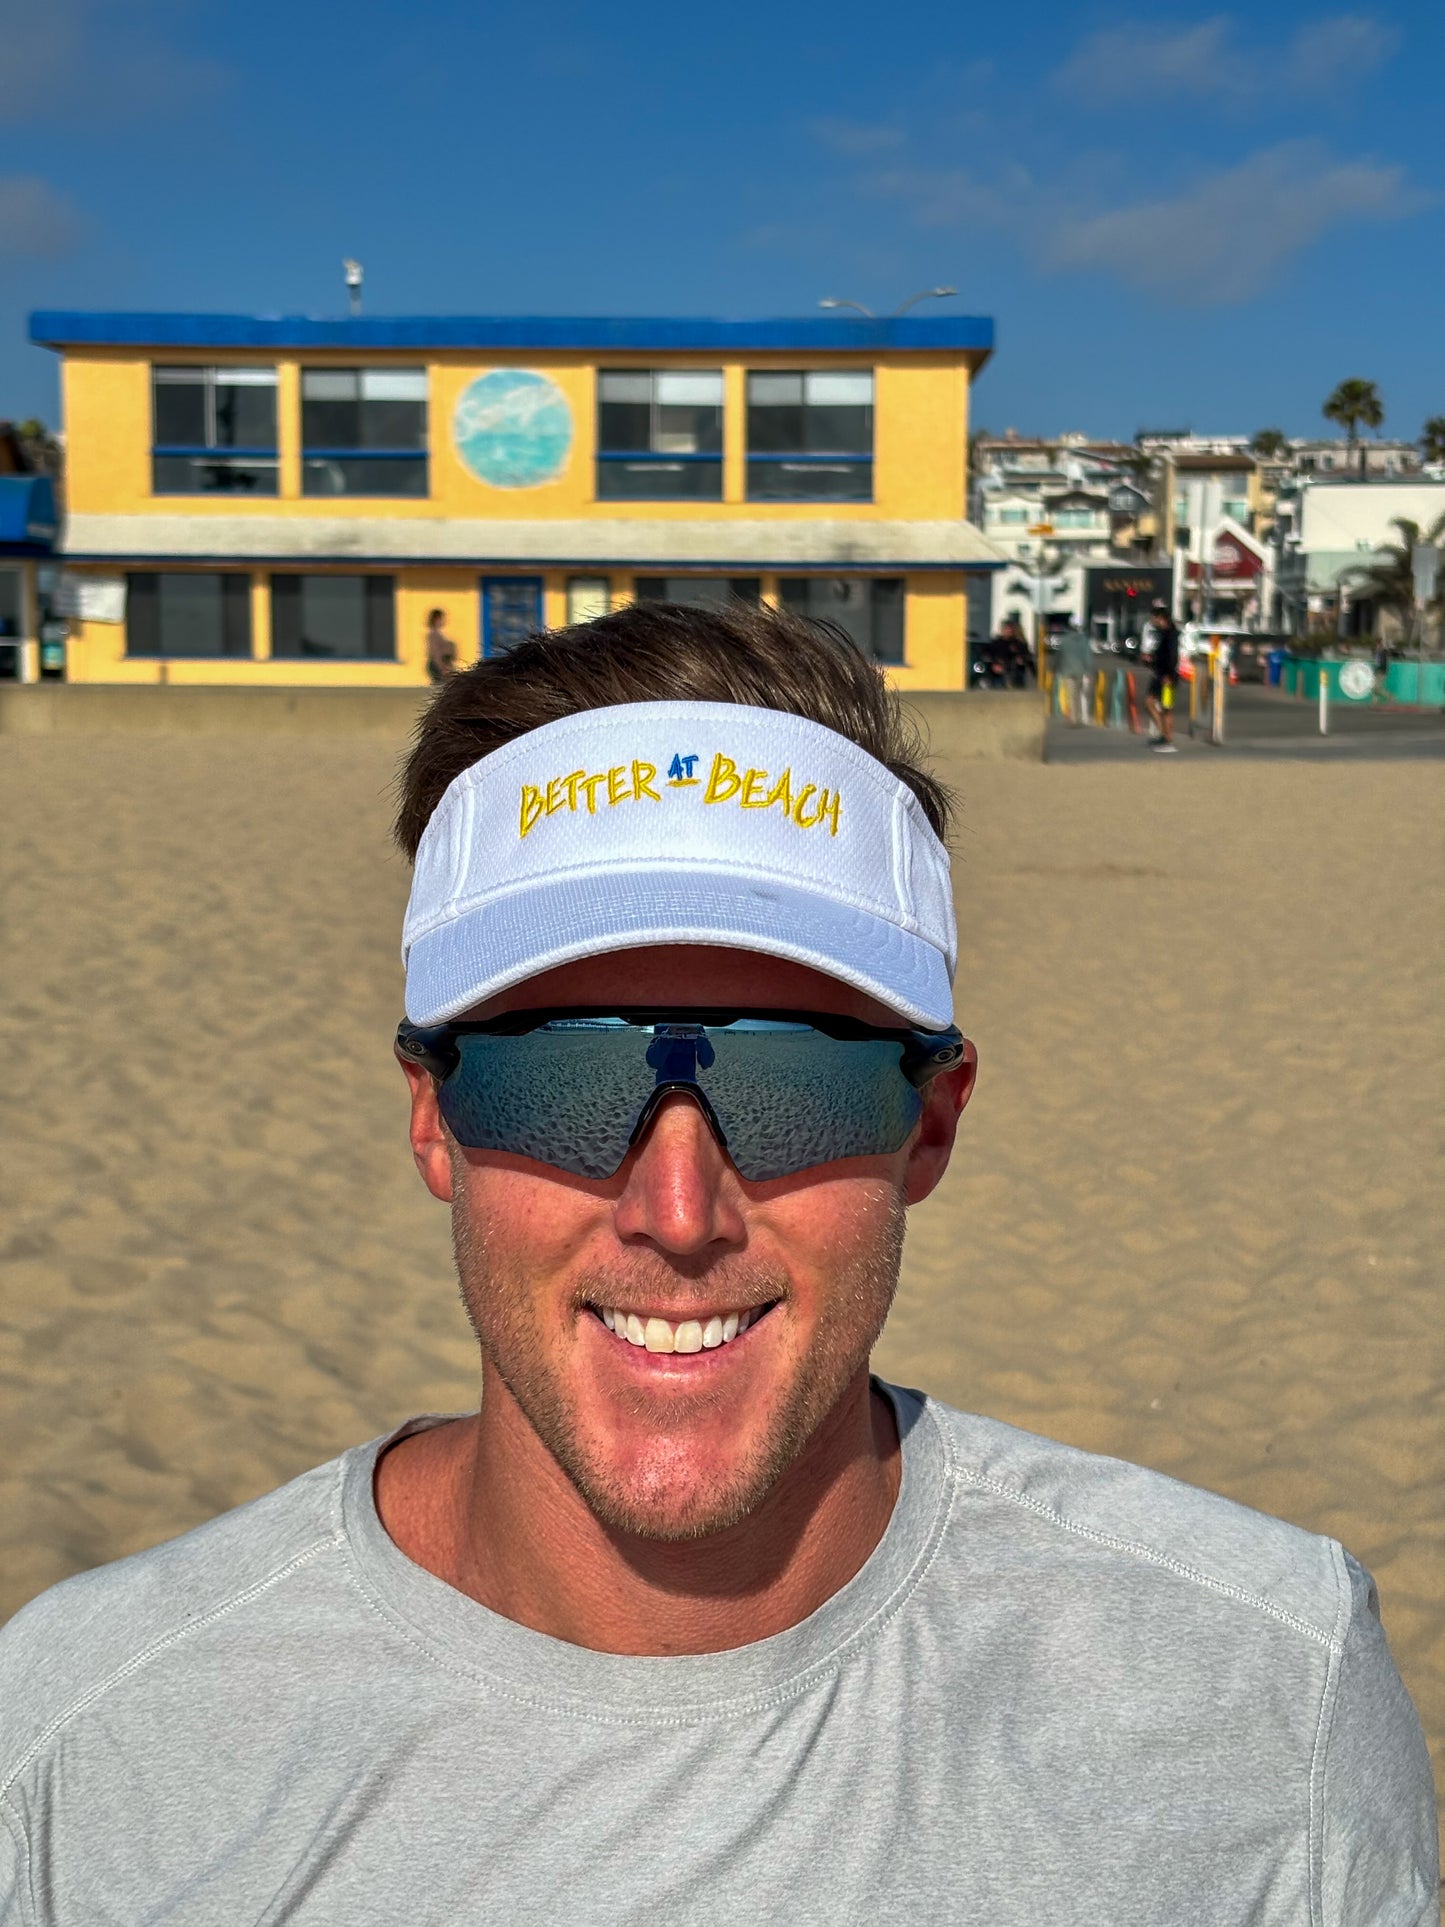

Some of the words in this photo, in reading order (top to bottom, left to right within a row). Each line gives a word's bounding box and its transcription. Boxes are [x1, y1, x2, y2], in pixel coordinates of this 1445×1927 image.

[520, 759, 662, 839] BETTER
[668, 753, 699, 780] AT
[704, 752, 842, 837] BEACH
